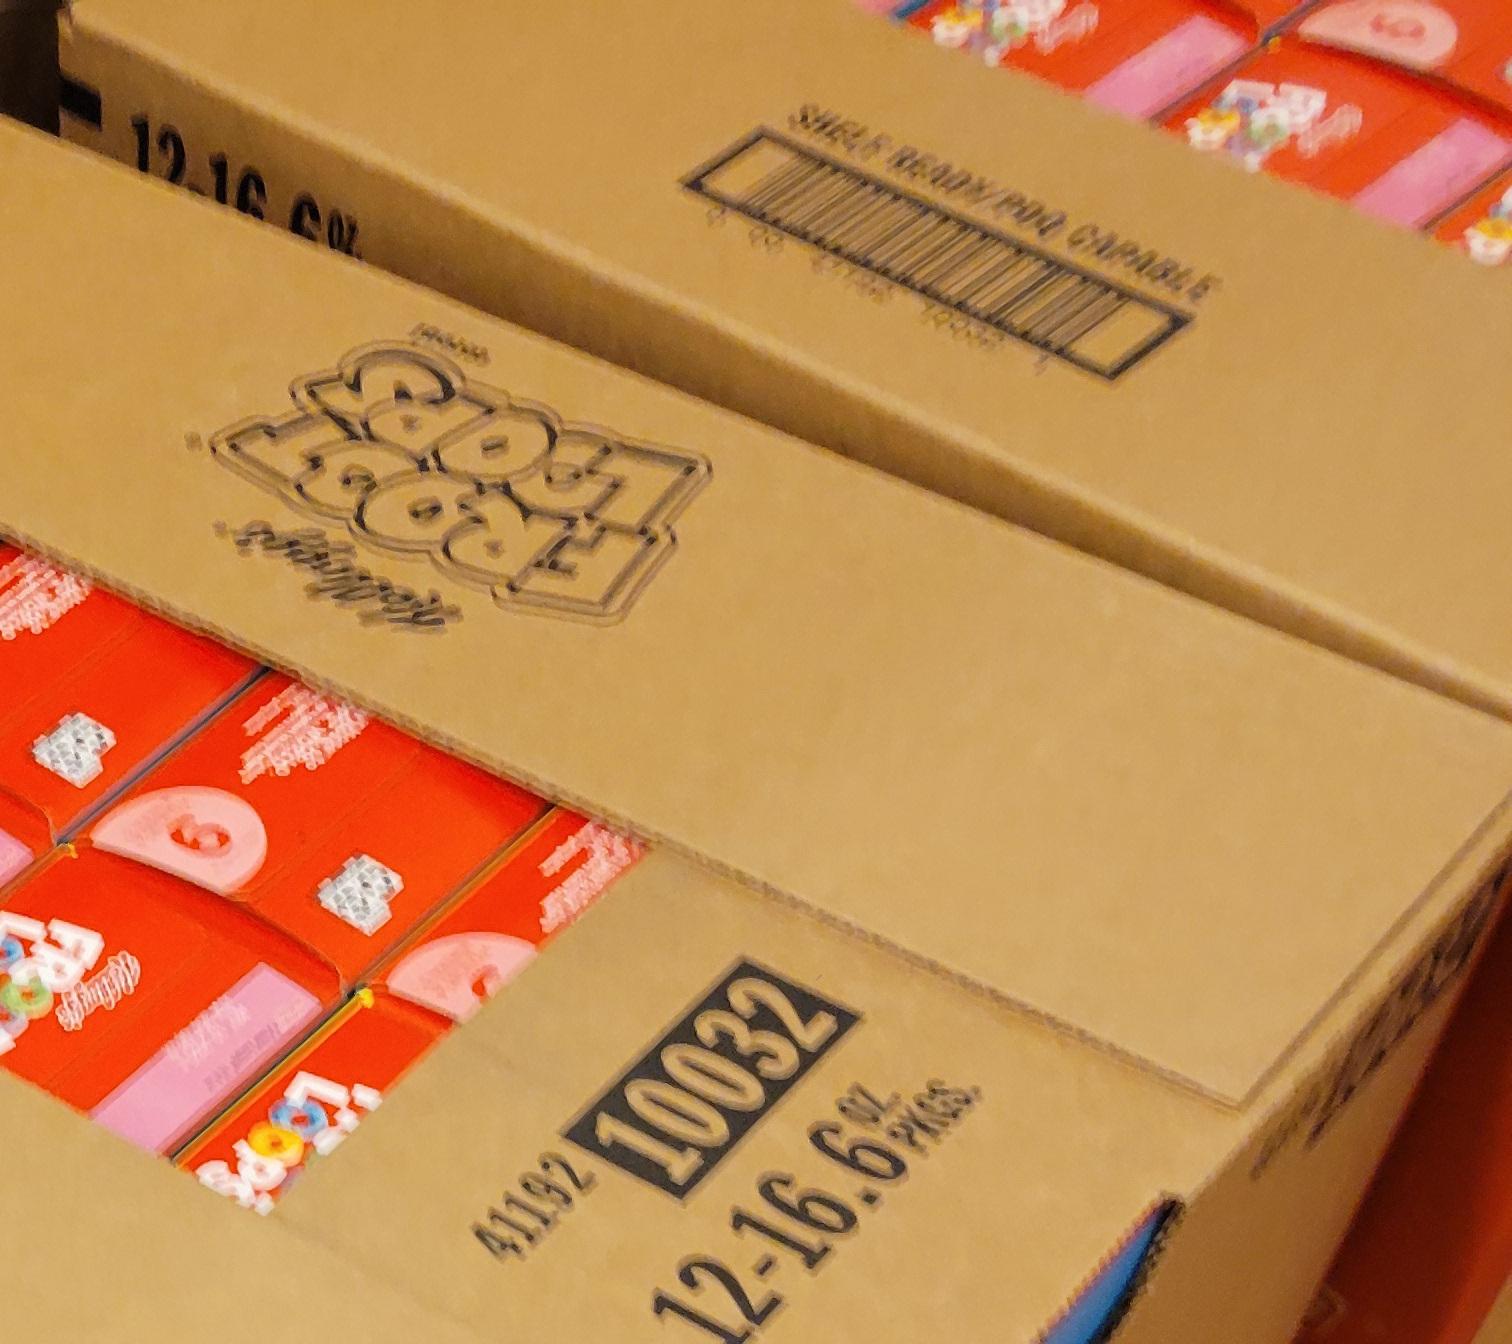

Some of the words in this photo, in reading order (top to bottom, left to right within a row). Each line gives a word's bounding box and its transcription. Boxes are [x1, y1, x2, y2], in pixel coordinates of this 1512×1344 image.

[210, 412, 676, 625] FROOT
[291, 340, 714, 545] LOOPS
[471, 1149, 599, 1264] 41192
[593, 976, 839, 1188] 10032
